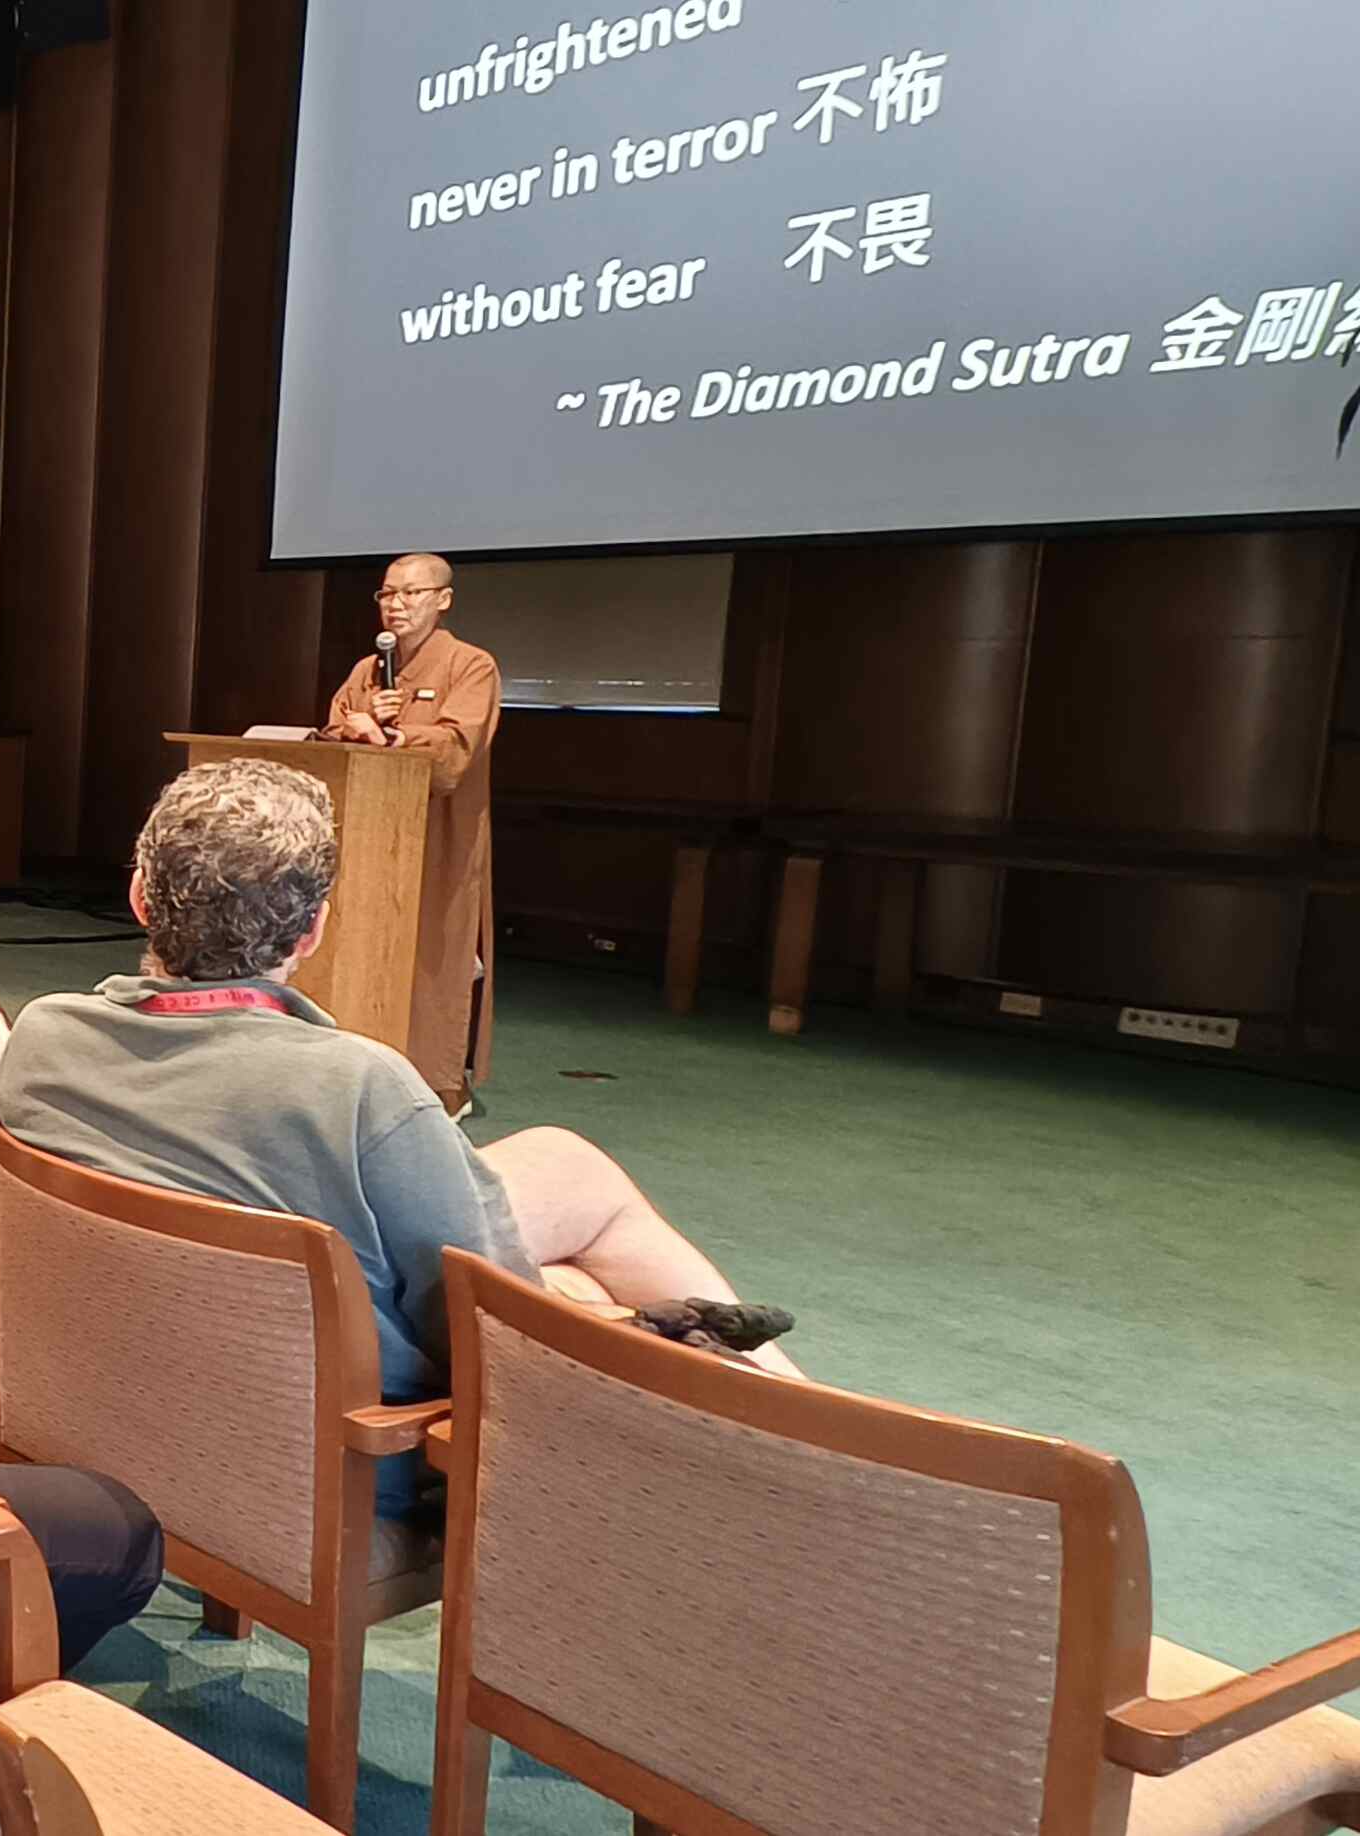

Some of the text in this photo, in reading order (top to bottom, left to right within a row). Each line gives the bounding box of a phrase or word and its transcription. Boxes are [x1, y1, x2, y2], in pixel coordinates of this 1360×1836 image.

[418, 0, 743, 113] unfrightened
[409, 49, 949, 230] never in terror 不怖
[399, 191, 933, 344] without fear 不畏
[597, 378, 680, 428] The
[690, 339, 946, 420] Diamond
[951, 326, 1132, 392] Sutra
